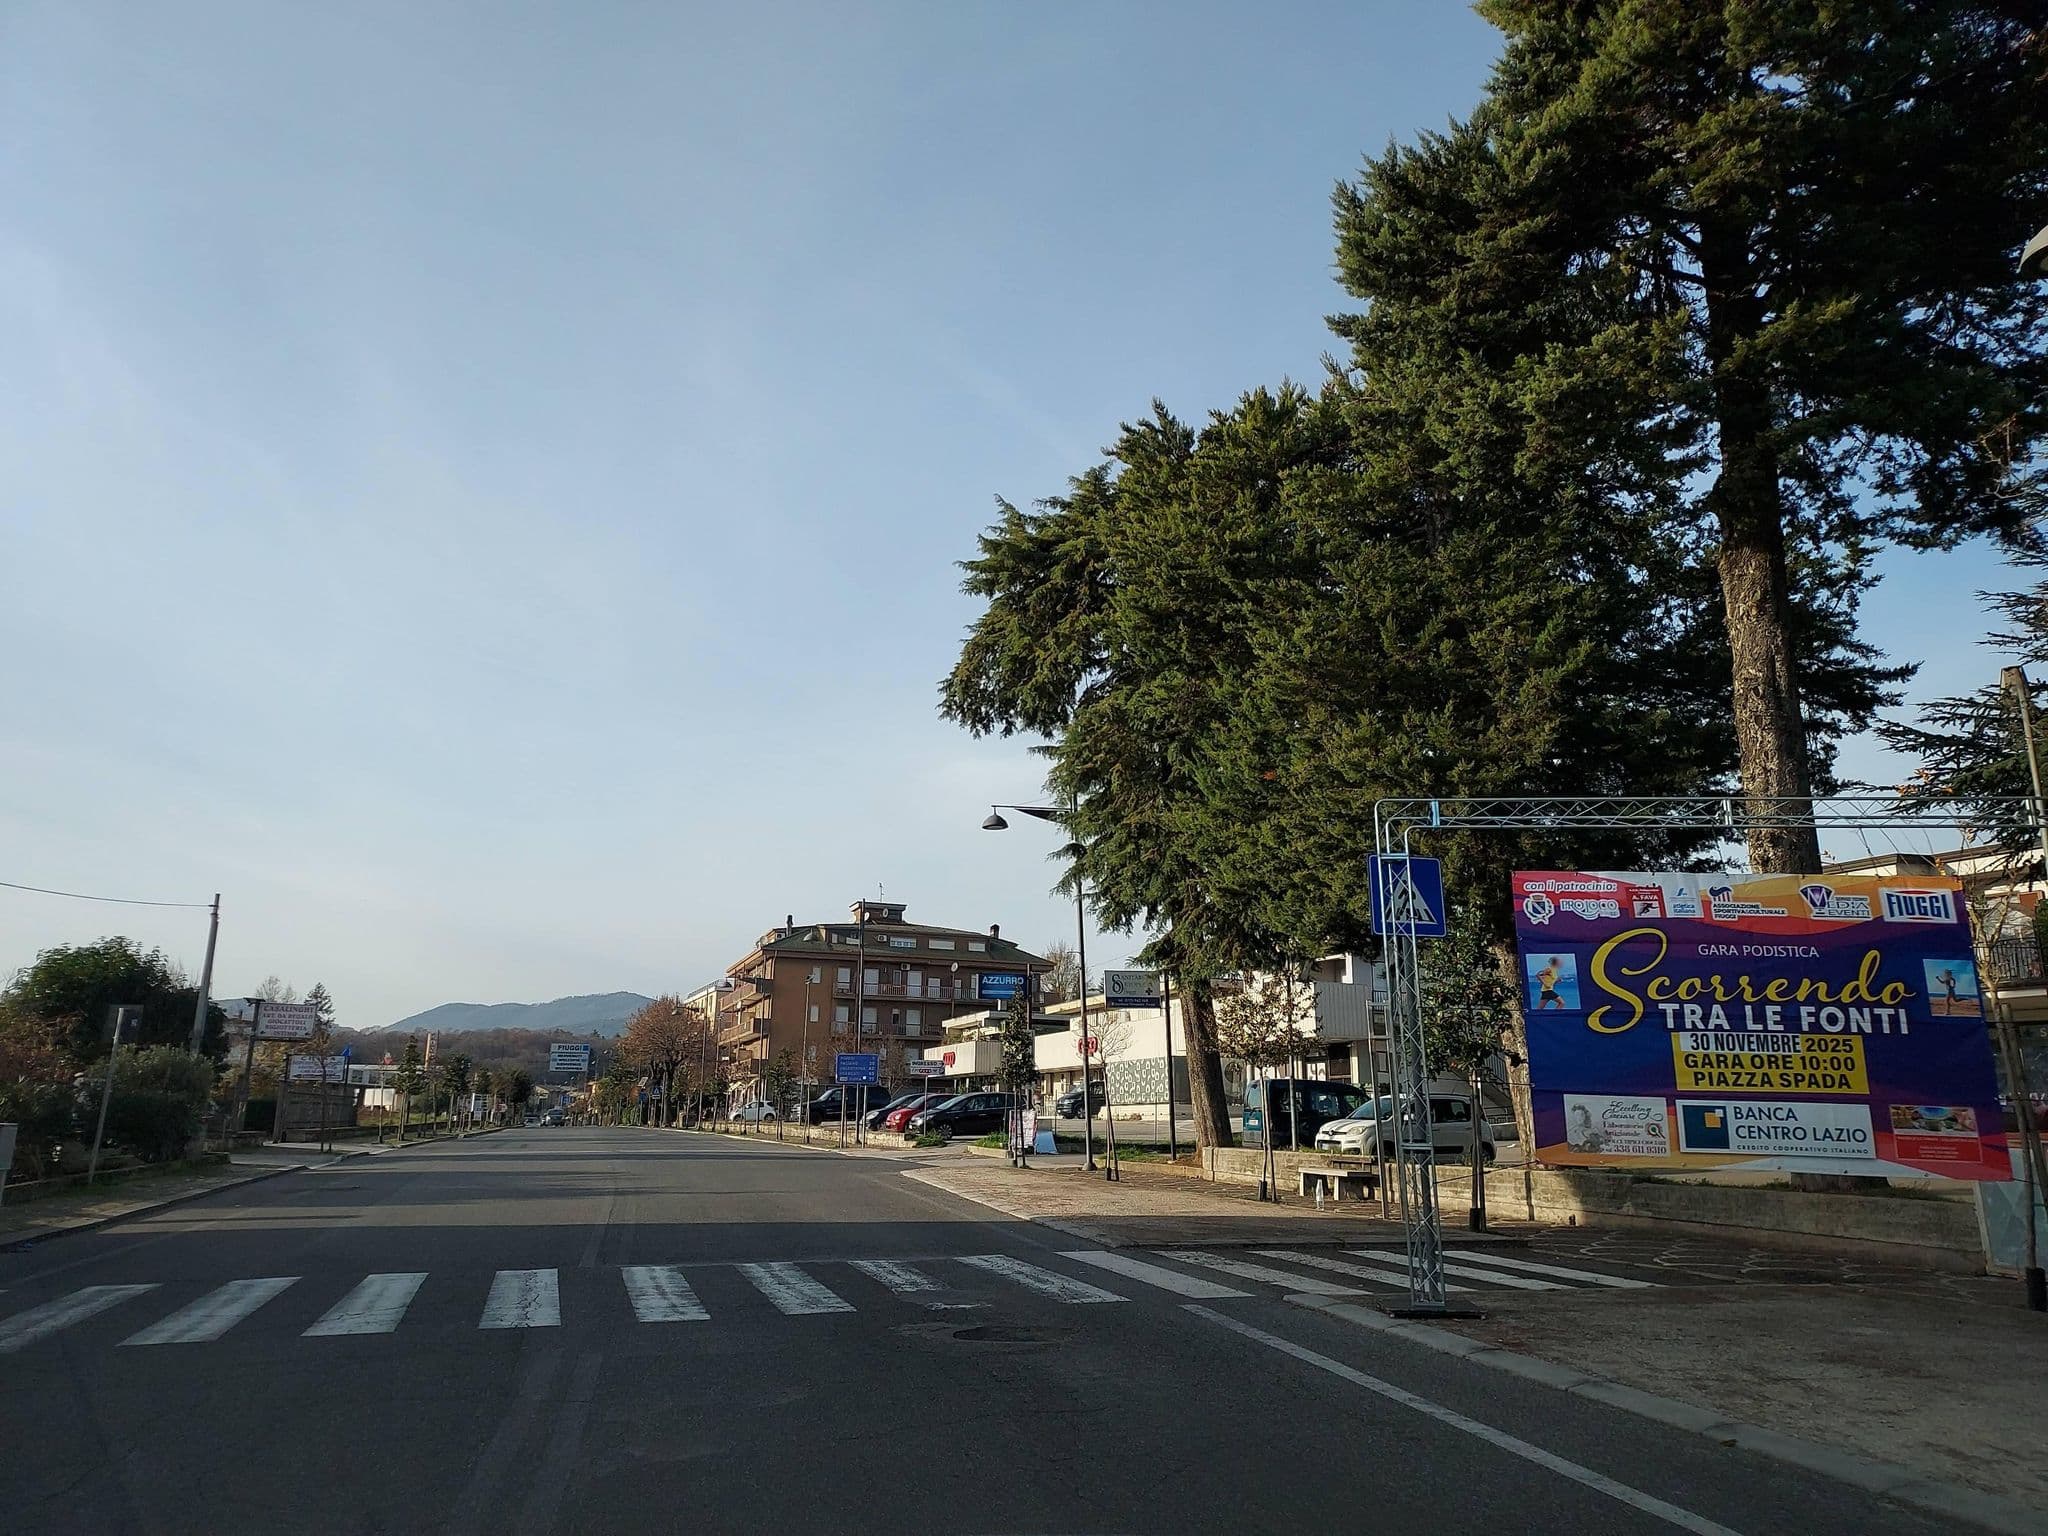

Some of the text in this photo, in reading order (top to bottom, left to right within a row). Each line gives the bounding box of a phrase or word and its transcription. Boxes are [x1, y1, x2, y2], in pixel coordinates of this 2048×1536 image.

[1524, 882, 1545, 892] con
[1546, 880, 1555, 892] il
[1557, 881, 1617, 893] patrocinio:
[1712, 903, 1761, 911] ASSOCIAZIONE
[1887, 893, 1950, 919] FIUGGI
[1697, 943, 1820, 958] GARA PODISTICA
[982, 976, 1024, 985] AZZURRO
[1587, 927, 1916, 1034] Scorrendo
[1658, 1003, 1909, 1034] TRA LE FONTI
[1690, 1032, 1853, 1054] 30 NOVEMBRE 2025
[1684, 1053, 1856, 1071] GARA ORE 10:00
[1693, 1071, 1852, 1089] PIAZZA SPADA
[1733, 1106, 1798, 1122] BANCA
[1735, 1125, 1867, 1143] CENTRO LAZIO
[1614, 1145, 1630, 1153] 338
[1632, 1145, 1645, 1154] 611
[1646, 1146, 1667, 1154] 9310
[1773, 1145, 1828, 1153] COOPERATIVO
